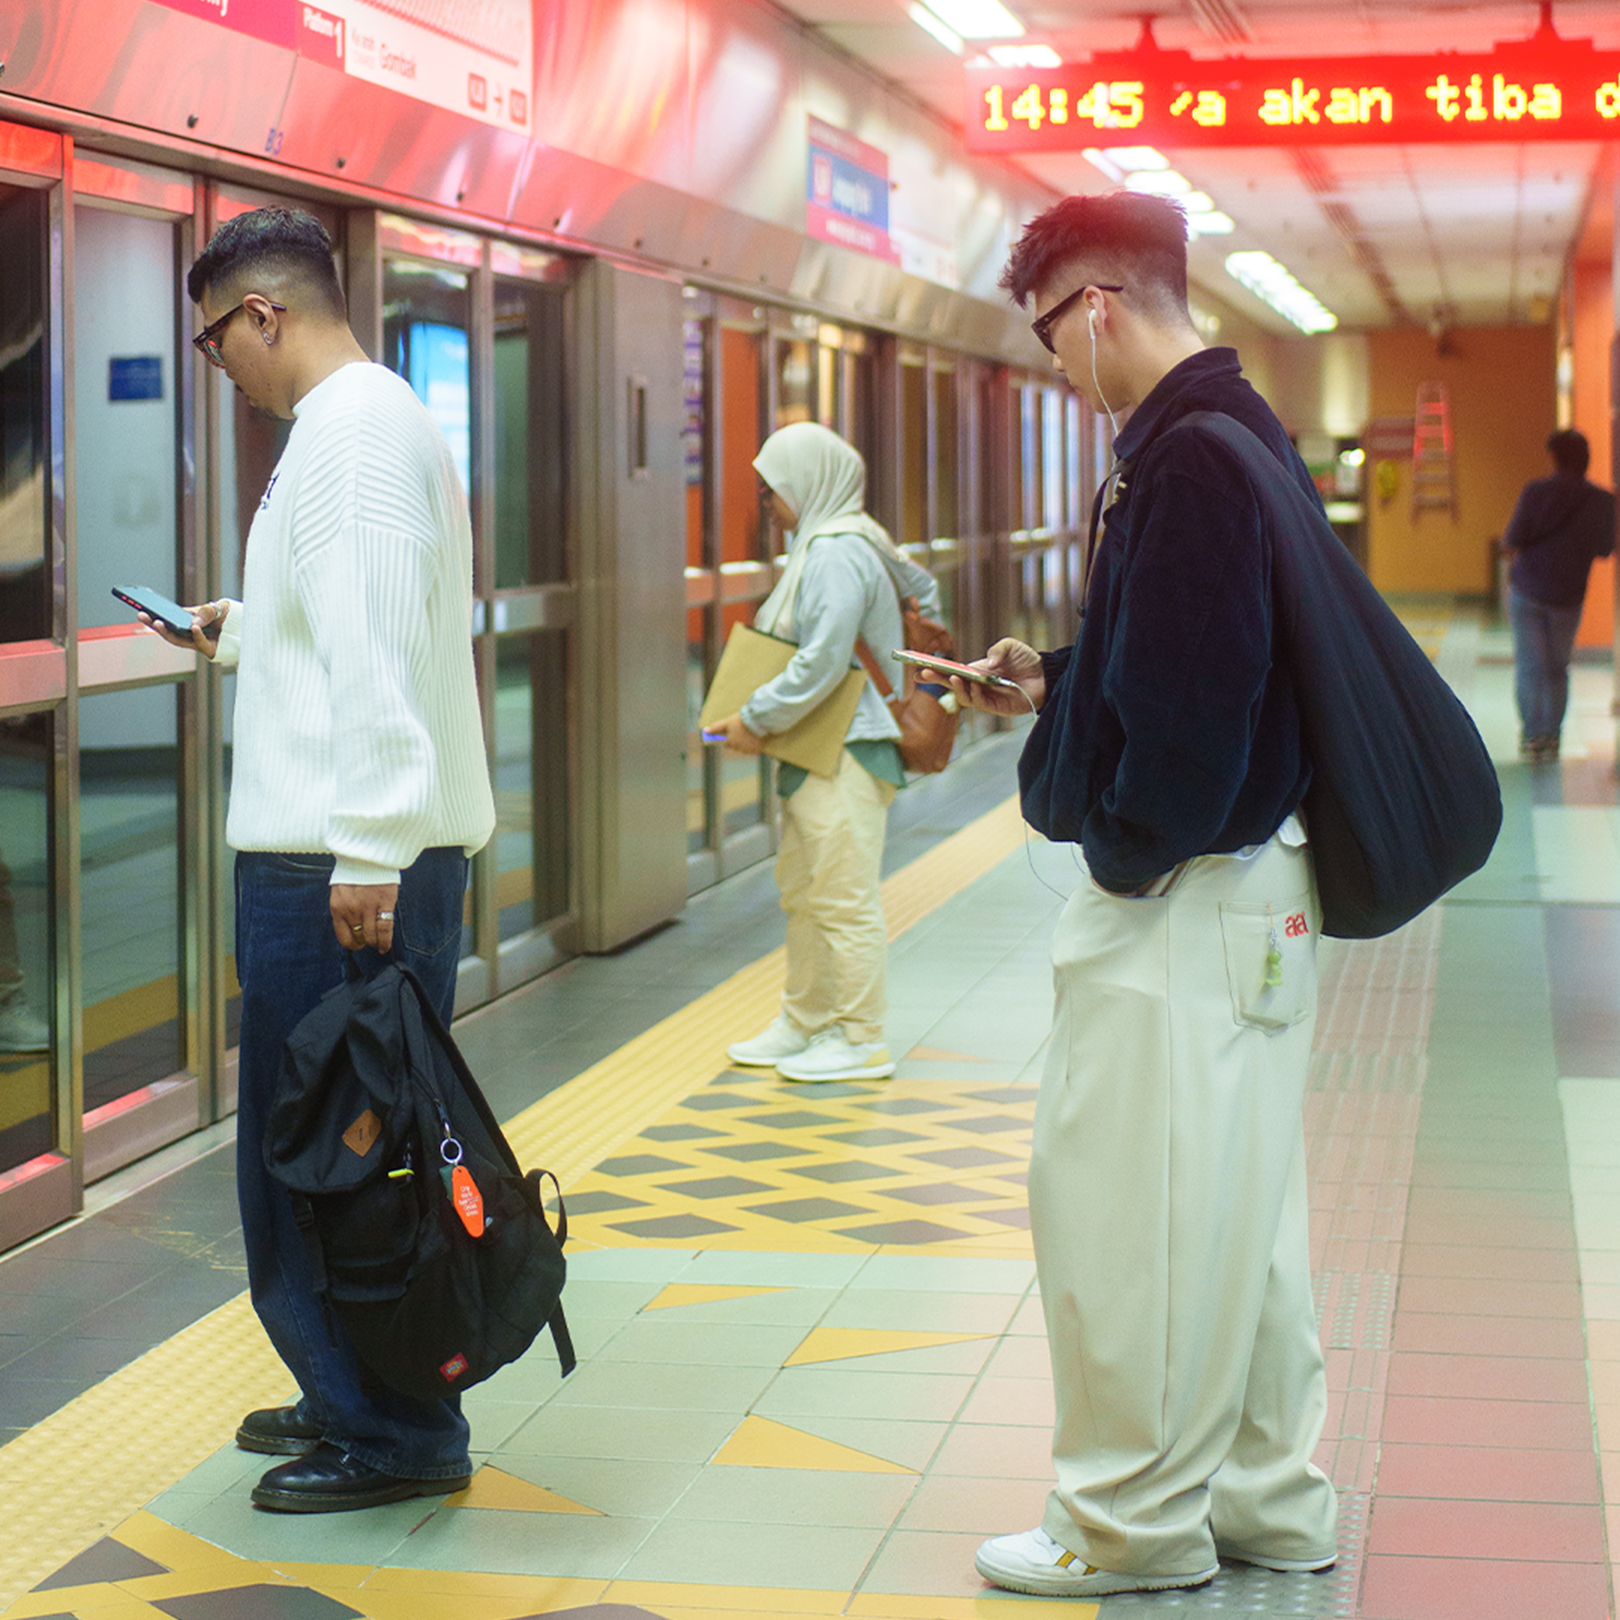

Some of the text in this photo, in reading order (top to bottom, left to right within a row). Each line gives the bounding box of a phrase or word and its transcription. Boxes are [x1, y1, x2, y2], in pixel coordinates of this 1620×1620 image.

[334, 20, 343, 58] 1
[379, 42, 417, 80] Gombak
[985, 82, 1143, 131] 14:45
[1259, 78, 1393, 124] akan
[1426, 74, 1561, 121] tiba
